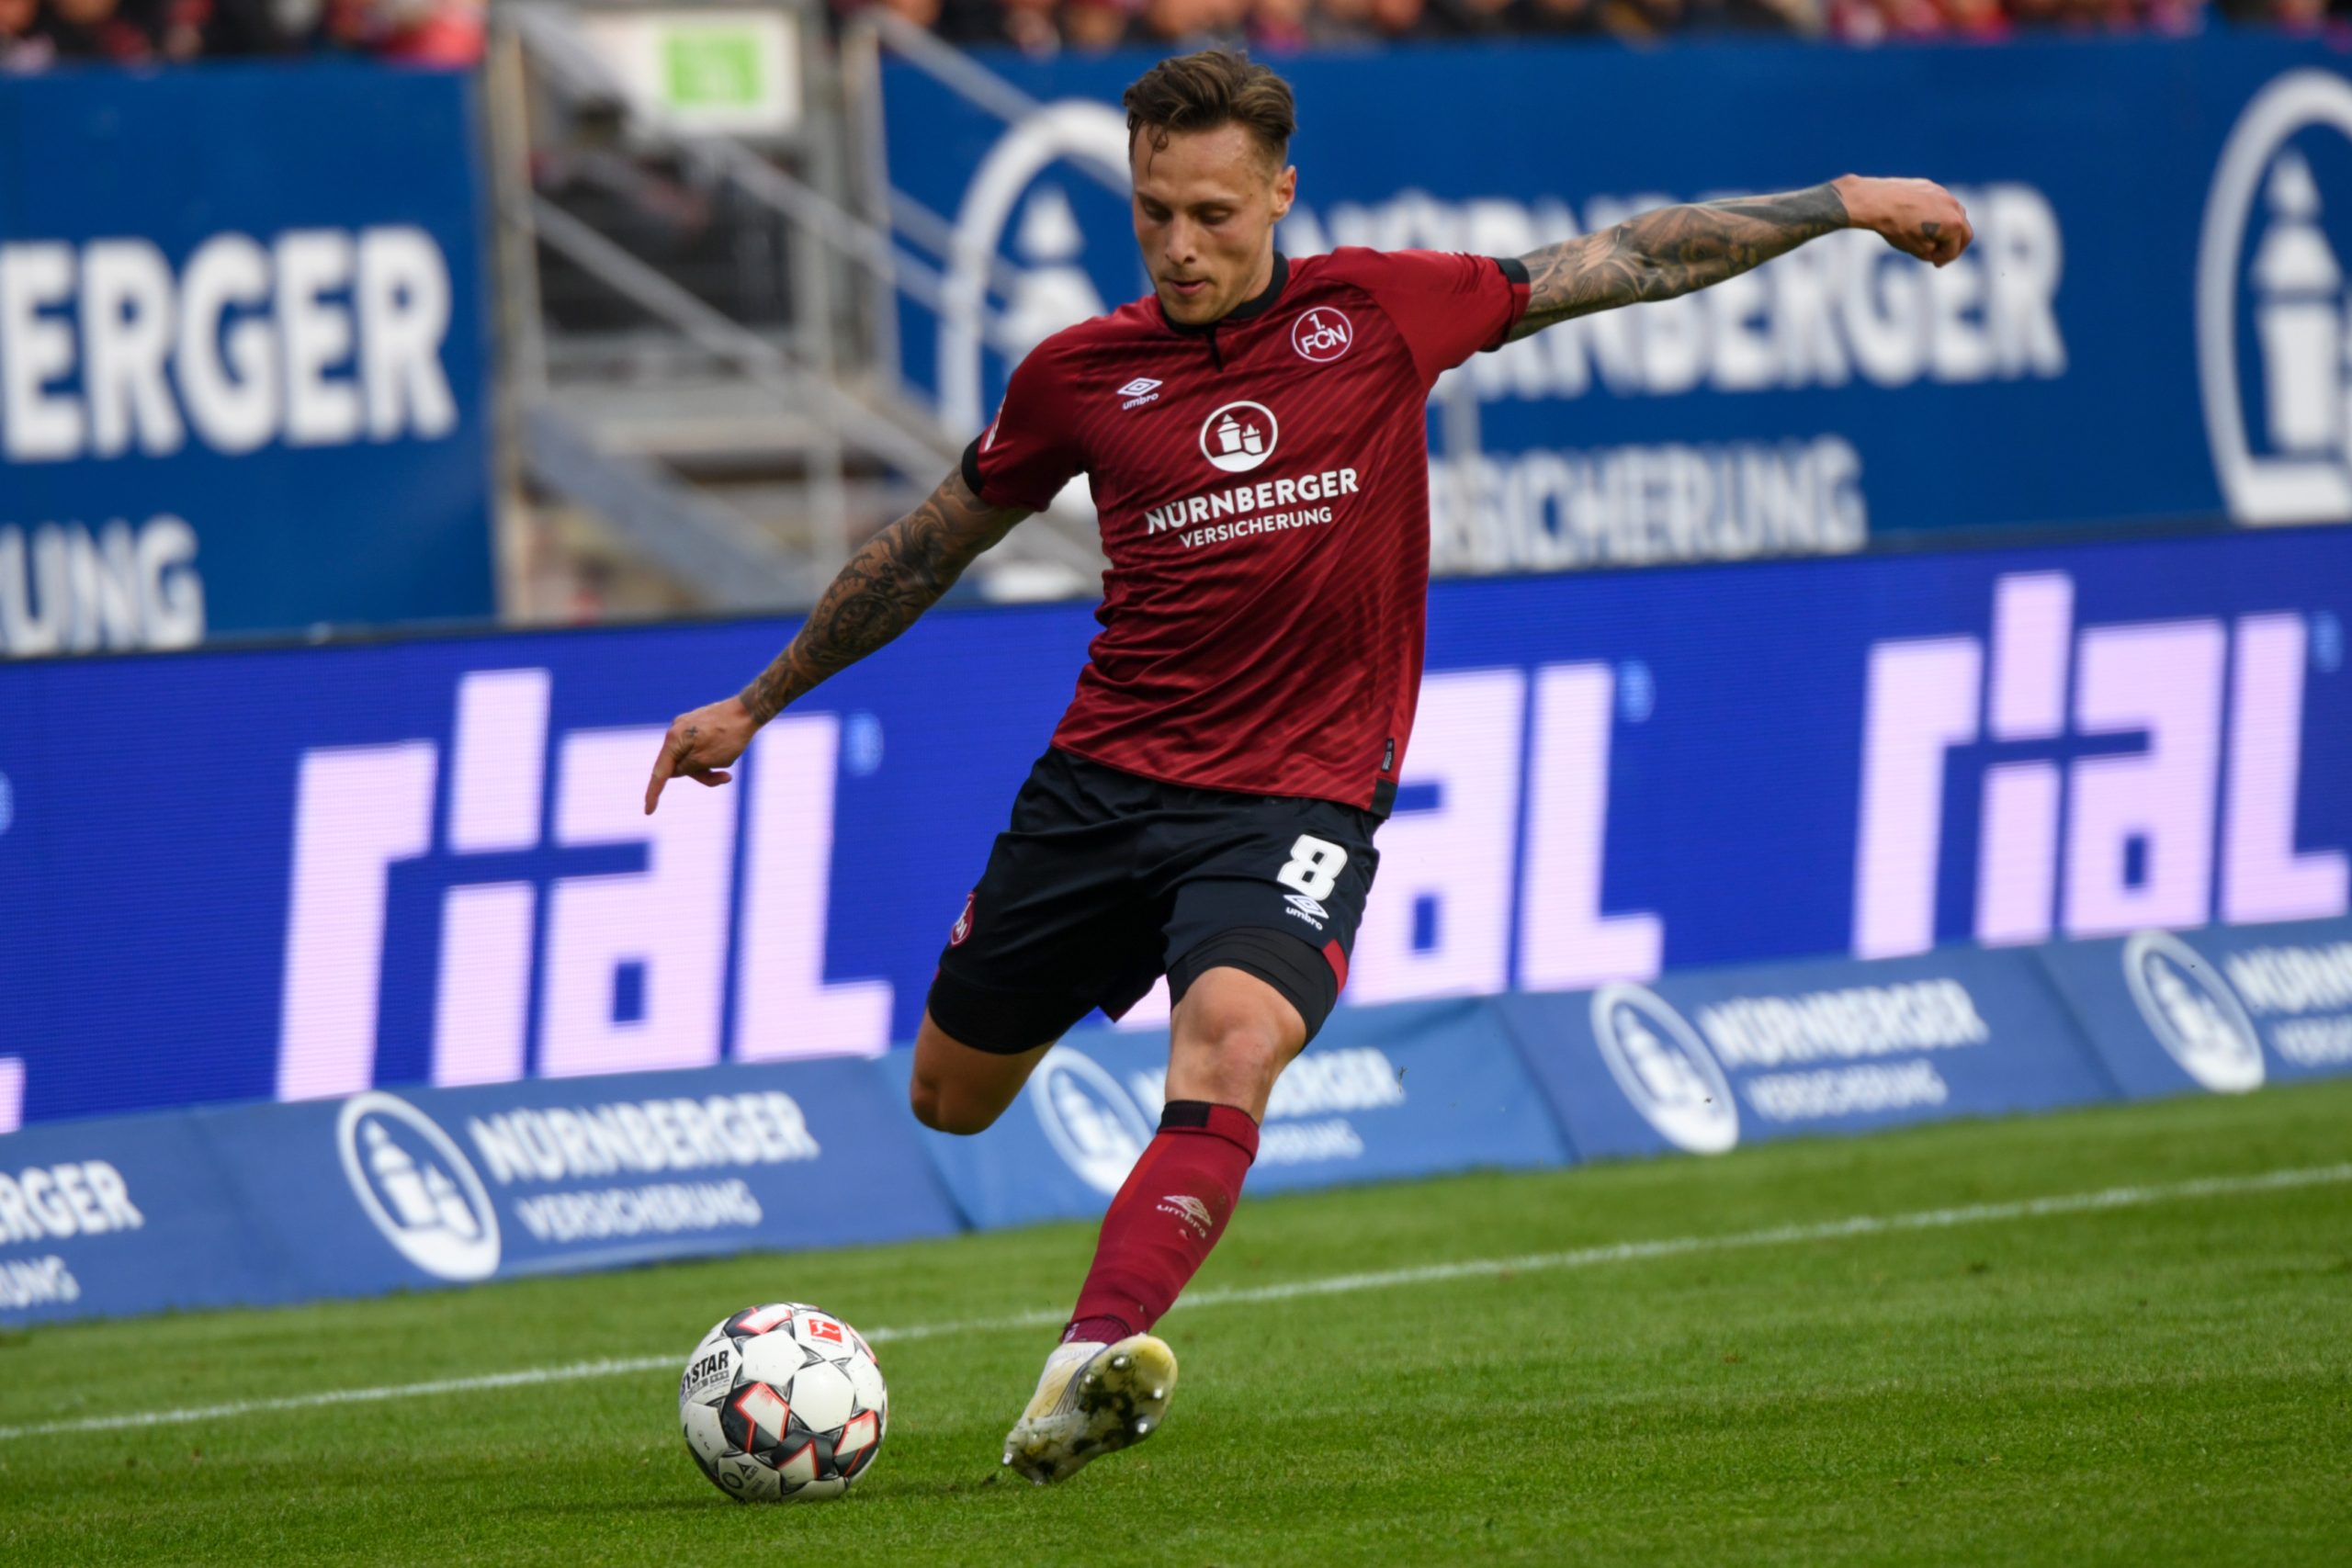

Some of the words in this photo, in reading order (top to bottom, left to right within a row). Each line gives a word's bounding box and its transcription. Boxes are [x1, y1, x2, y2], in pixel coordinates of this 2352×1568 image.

[1301, 324, 1348, 355] FCN
[1122, 392, 1159, 411] umbro
[1145, 468, 1360, 535] NÜRNBERGER
[1180, 506, 1333, 548] VERSICHERUNG
[1276, 833, 1348, 901] 8
[1285, 907, 1323, 931] umbro
[469, 1090, 820, 1185] NÜRNBERGER
[0, 1160, 144, 1246] RGER
[1157, 1203, 1206, 1239] umbro
